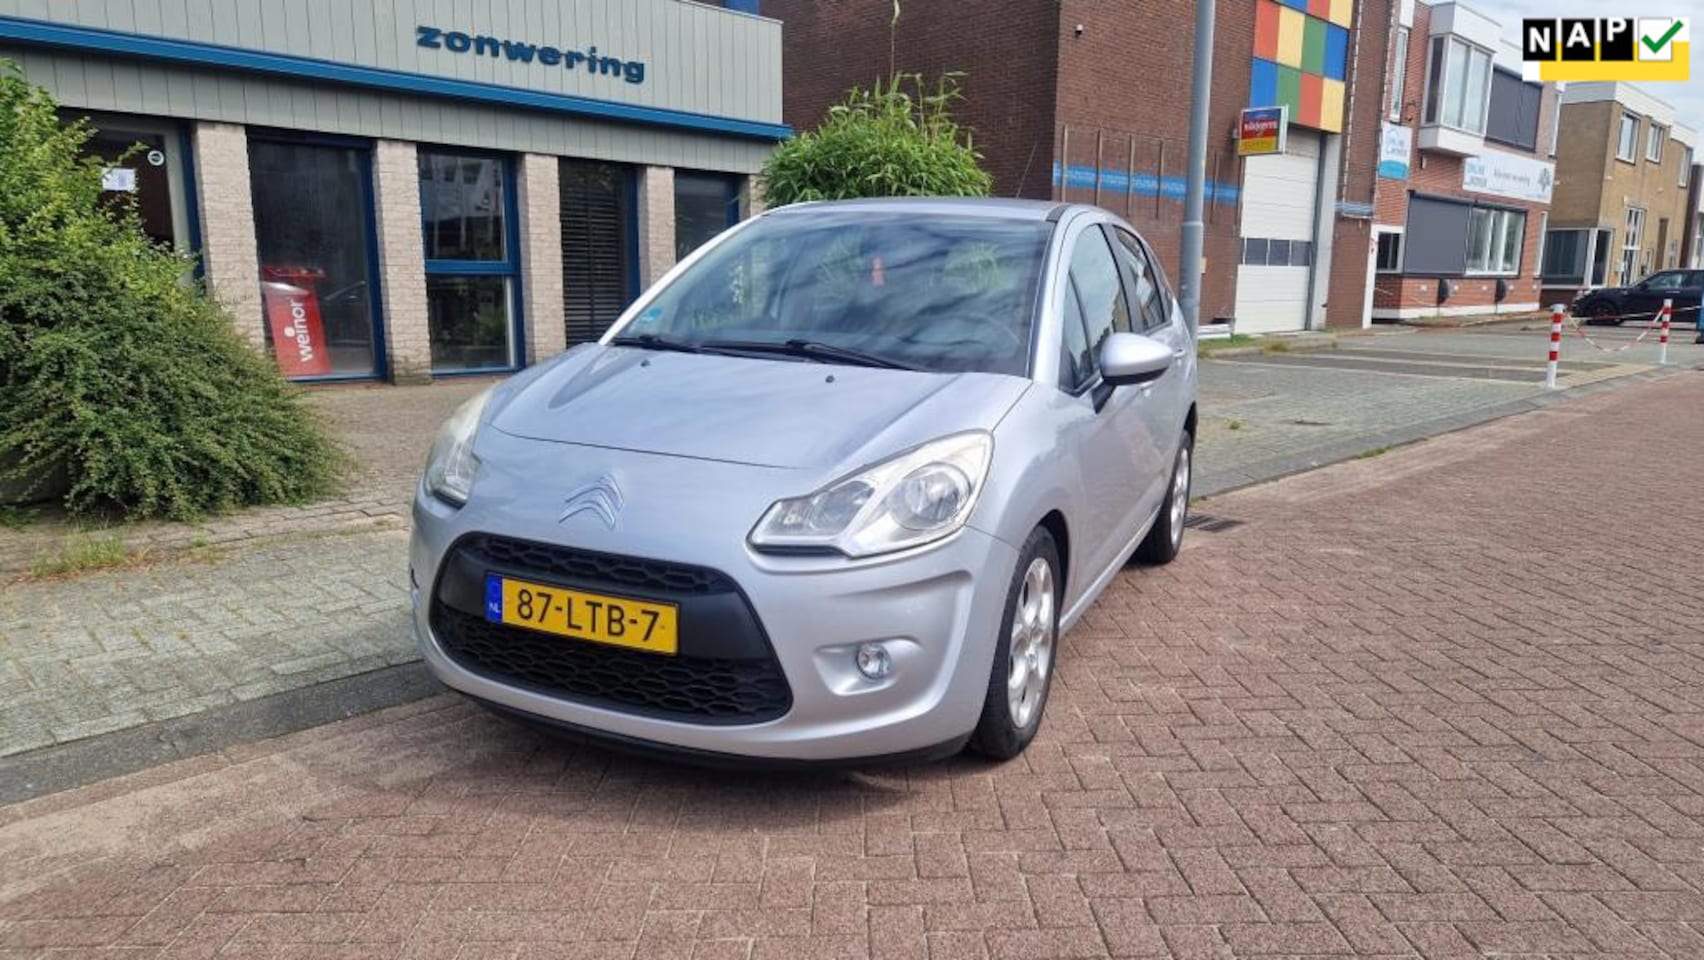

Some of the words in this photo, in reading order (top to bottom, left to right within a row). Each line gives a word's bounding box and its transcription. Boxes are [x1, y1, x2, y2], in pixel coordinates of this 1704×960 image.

[417, 25, 645, 84] zonwering
[284, 298, 314, 362] weinor
[488, 602, 502, 614] NL
[517, 588, 660, 642] 87-LTB-7
